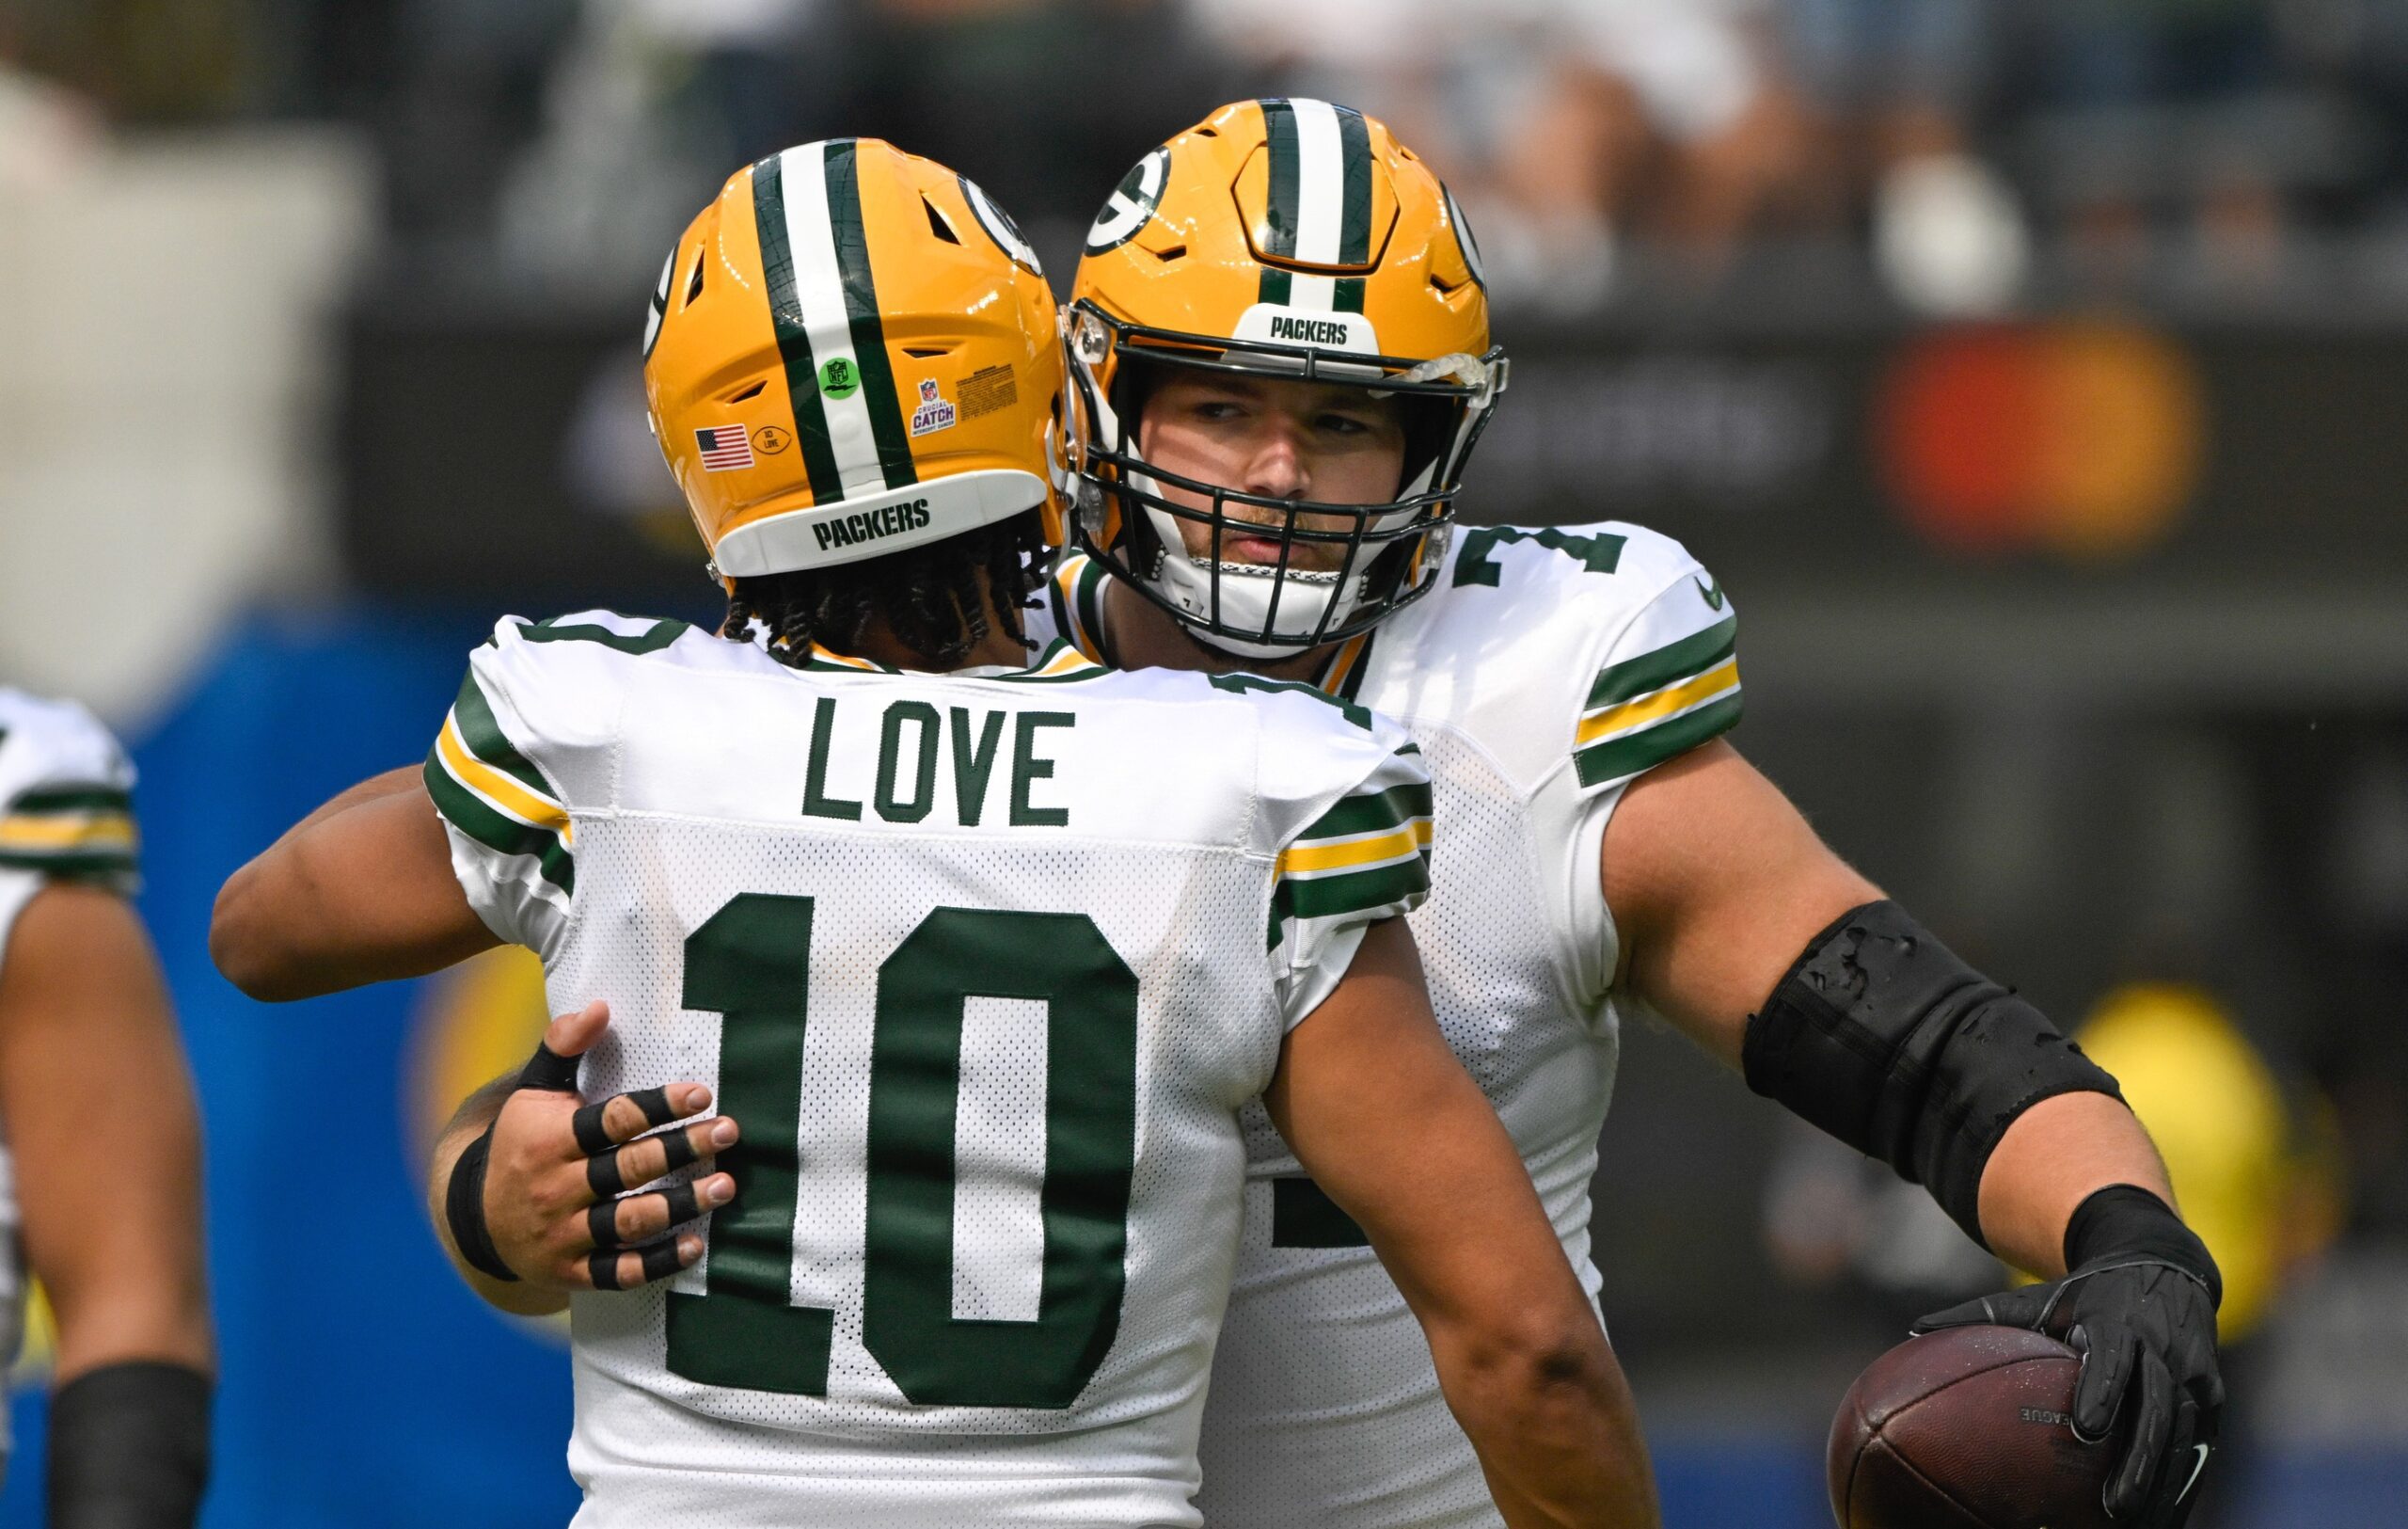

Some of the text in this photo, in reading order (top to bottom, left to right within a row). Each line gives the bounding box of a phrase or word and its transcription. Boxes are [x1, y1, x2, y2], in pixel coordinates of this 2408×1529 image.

[1270, 316, 1347, 345] PACKERS
[913, 406, 954, 429] CATCH
[918, 401, 946, 414] CRUCIAL
[812, 498, 930, 551] PACKERS
[801, 697, 1076, 827] LOVE
[665, 892, 1140, 1410] 10
[2020, 1408, 2070, 1425] EAGUE
